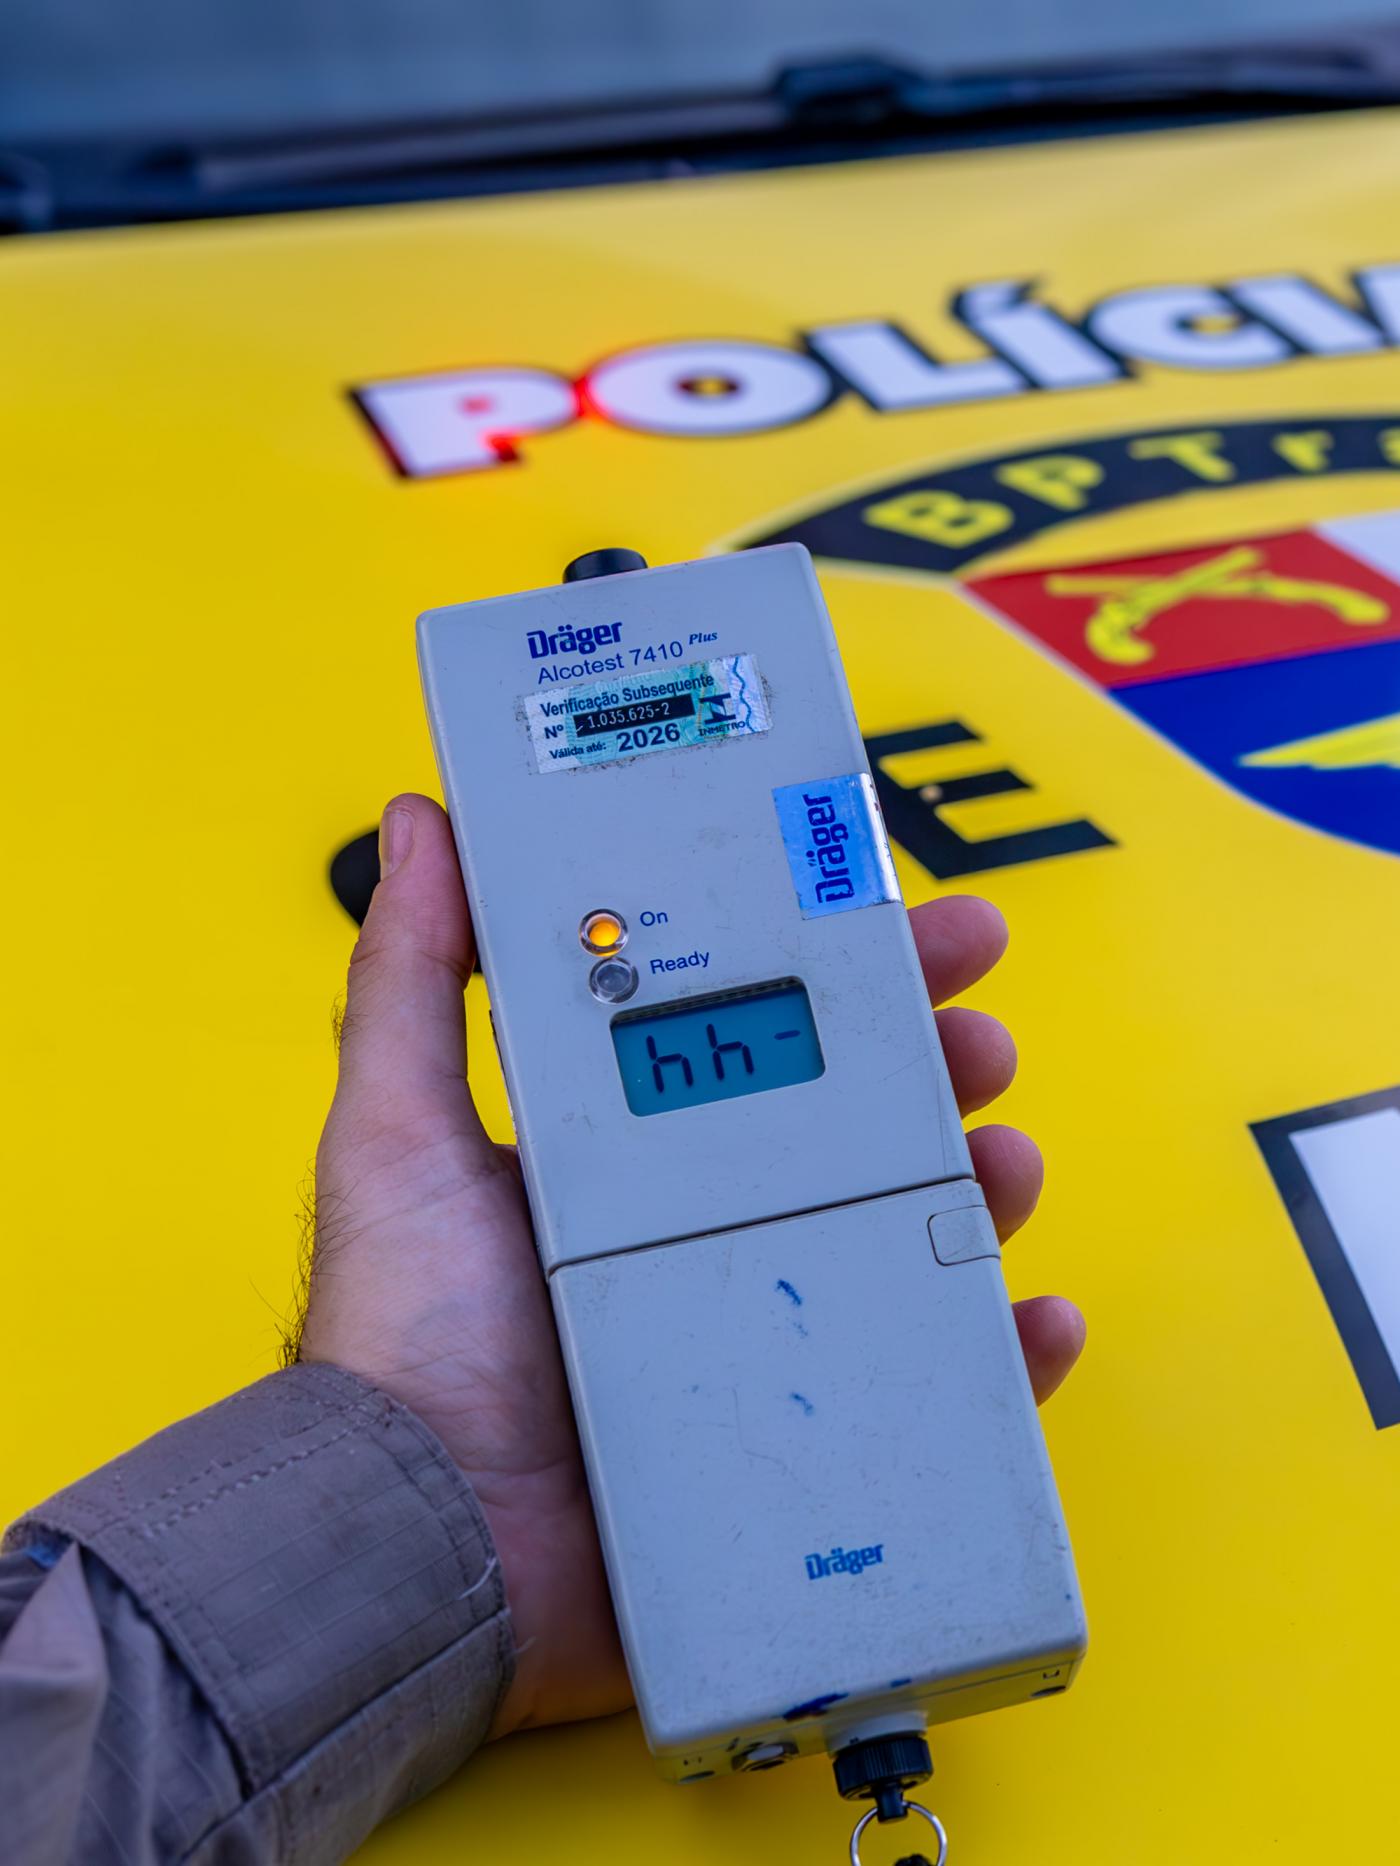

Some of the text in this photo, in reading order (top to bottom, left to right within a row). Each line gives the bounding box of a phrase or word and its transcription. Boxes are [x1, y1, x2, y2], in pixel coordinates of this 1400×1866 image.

[526, 621, 623, 659] Dräger
[538, 653, 625, 685] Alcotest
[628, 641, 683, 666] 7410
[688, 632, 718, 645] Plus
[540, 691, 620, 717] Verificação
[622, 673, 715, 701] Subsequente
[587, 702, 670, 729] 1.035.625-2
[698, 721, 746, 736] INMETRO
[549, 722, 680, 759] Válida até: 2026
[803, 793, 855, 904] Dräger
[640, 911, 668, 927] On
[650, 951, 710, 974] Ready
[804, 1544, 883, 1581] Dräger
